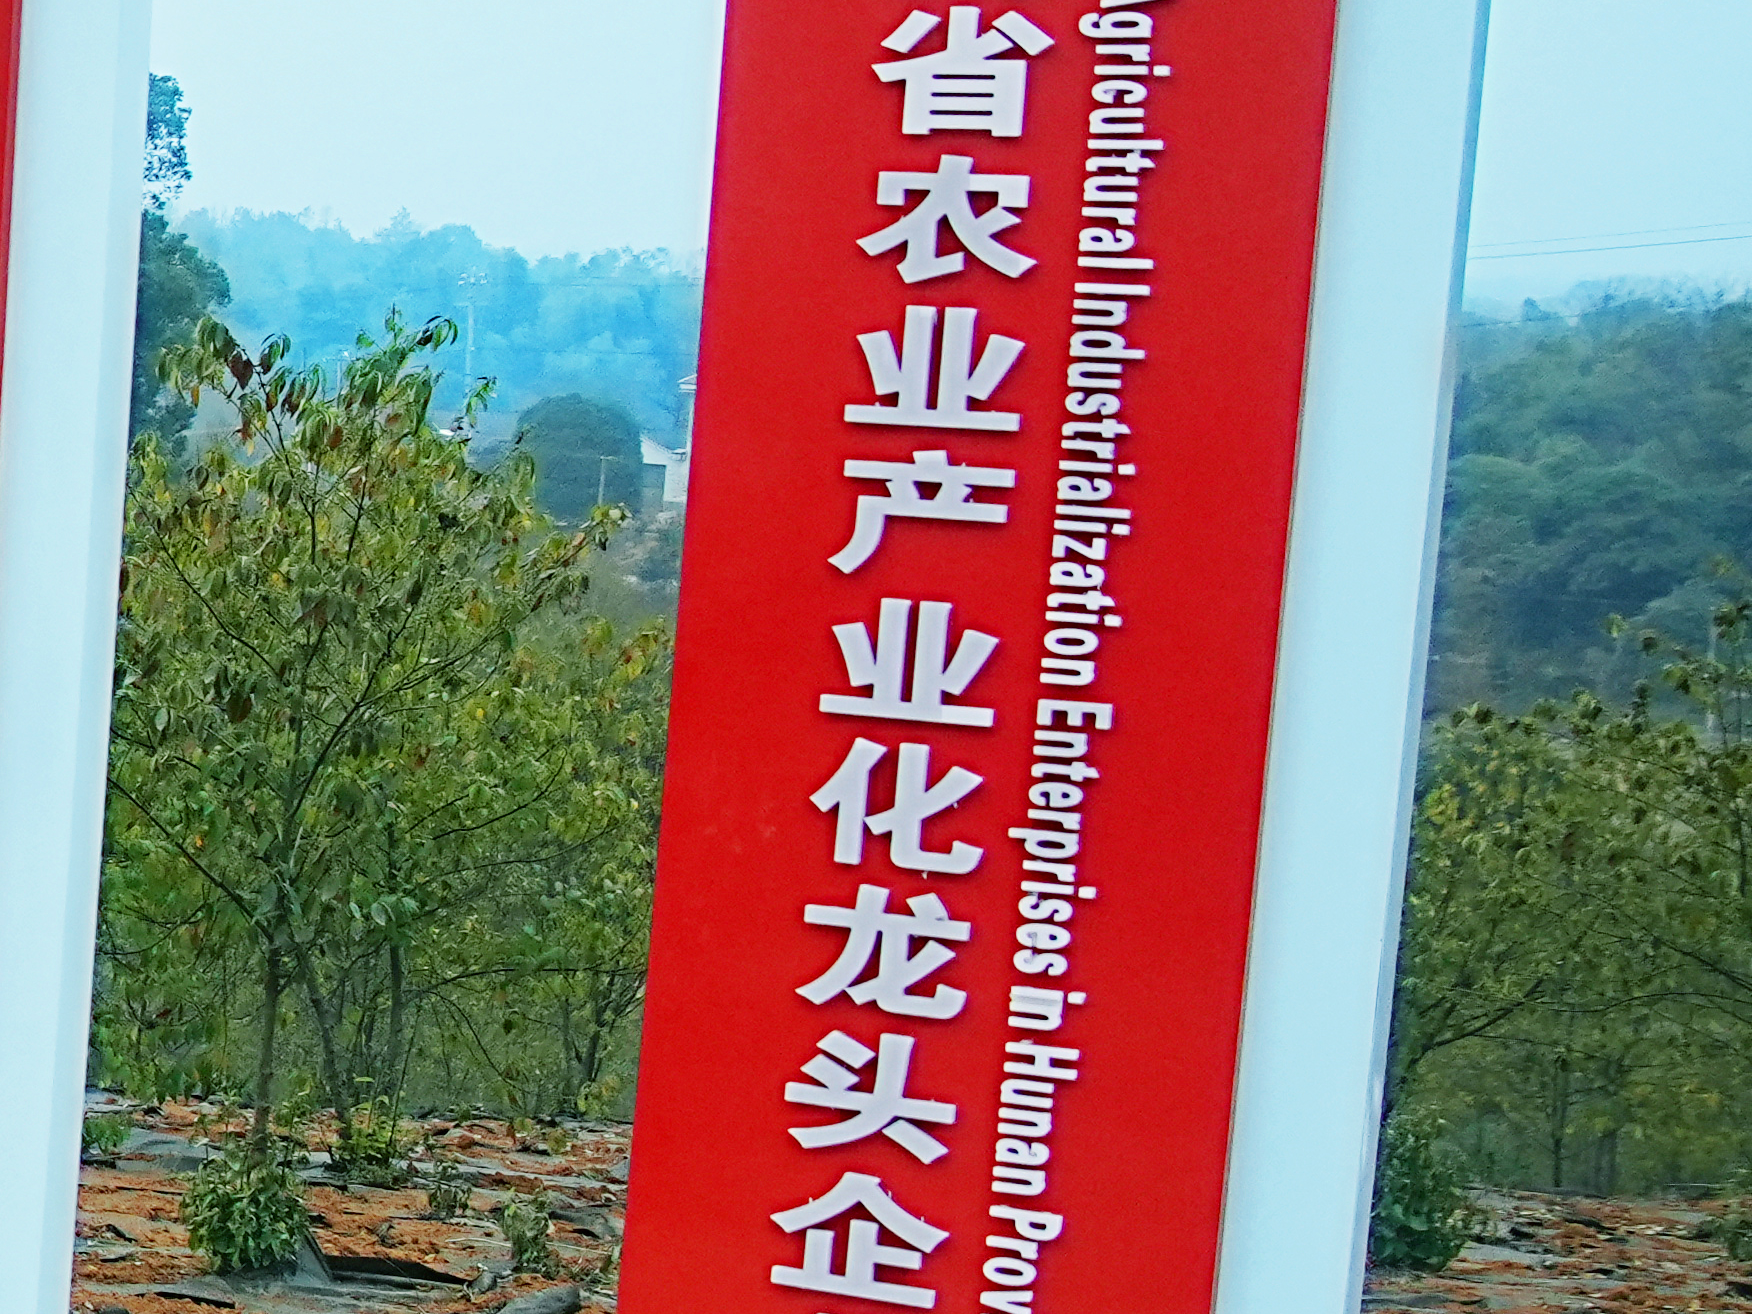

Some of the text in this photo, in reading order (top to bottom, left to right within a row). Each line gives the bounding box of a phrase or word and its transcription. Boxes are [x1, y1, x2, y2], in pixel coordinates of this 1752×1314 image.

[1040, 283, 1150, 685] Industrialization
[1008, 699, 1112, 976] Enterprises
[1008, 986, 1086, 1030] in
[992, 1040, 1079, 1195] Hunan
